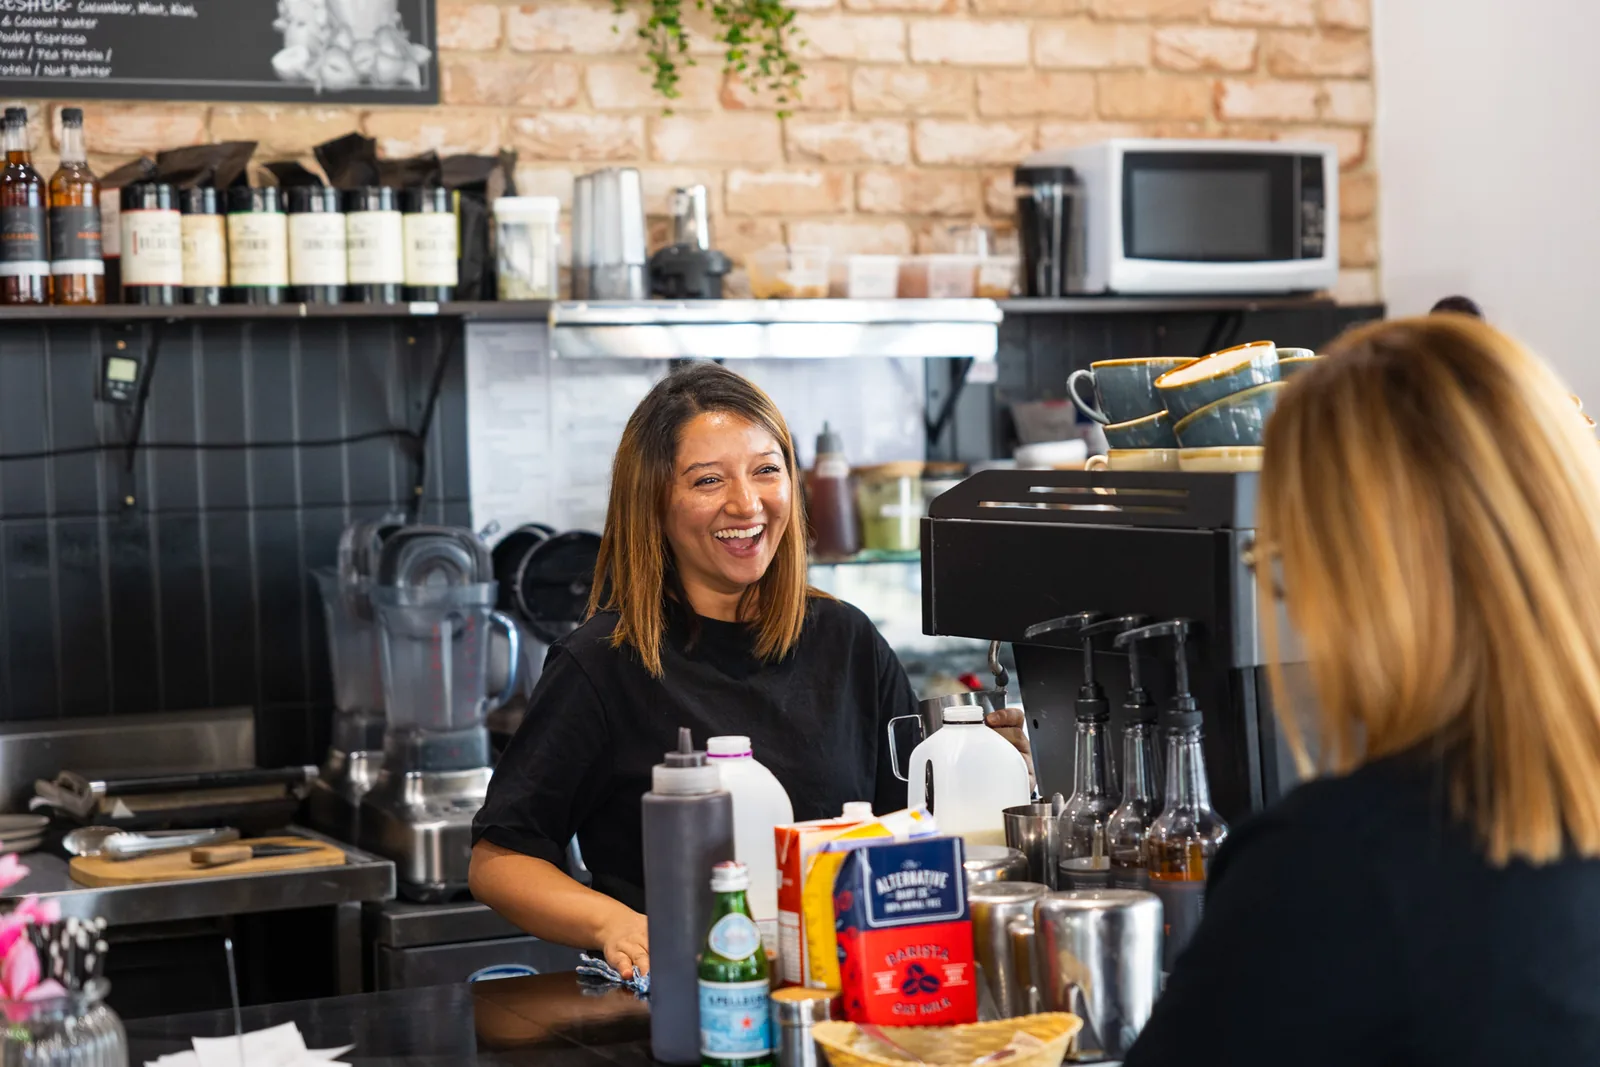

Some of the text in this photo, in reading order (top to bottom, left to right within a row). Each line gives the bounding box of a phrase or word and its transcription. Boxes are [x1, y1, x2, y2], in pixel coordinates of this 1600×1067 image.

[14, 14, 59, 28] Coconut
[34, 31, 87, 47] Espresso
[61, 48, 104, 62] Protein
[43, 64, 66, 77] Nut
[876, 869, 949, 896] ALTERNATIVE
[885, 945, 949, 967] BARISTA
[891, 998, 951, 1016] OAT MILK
